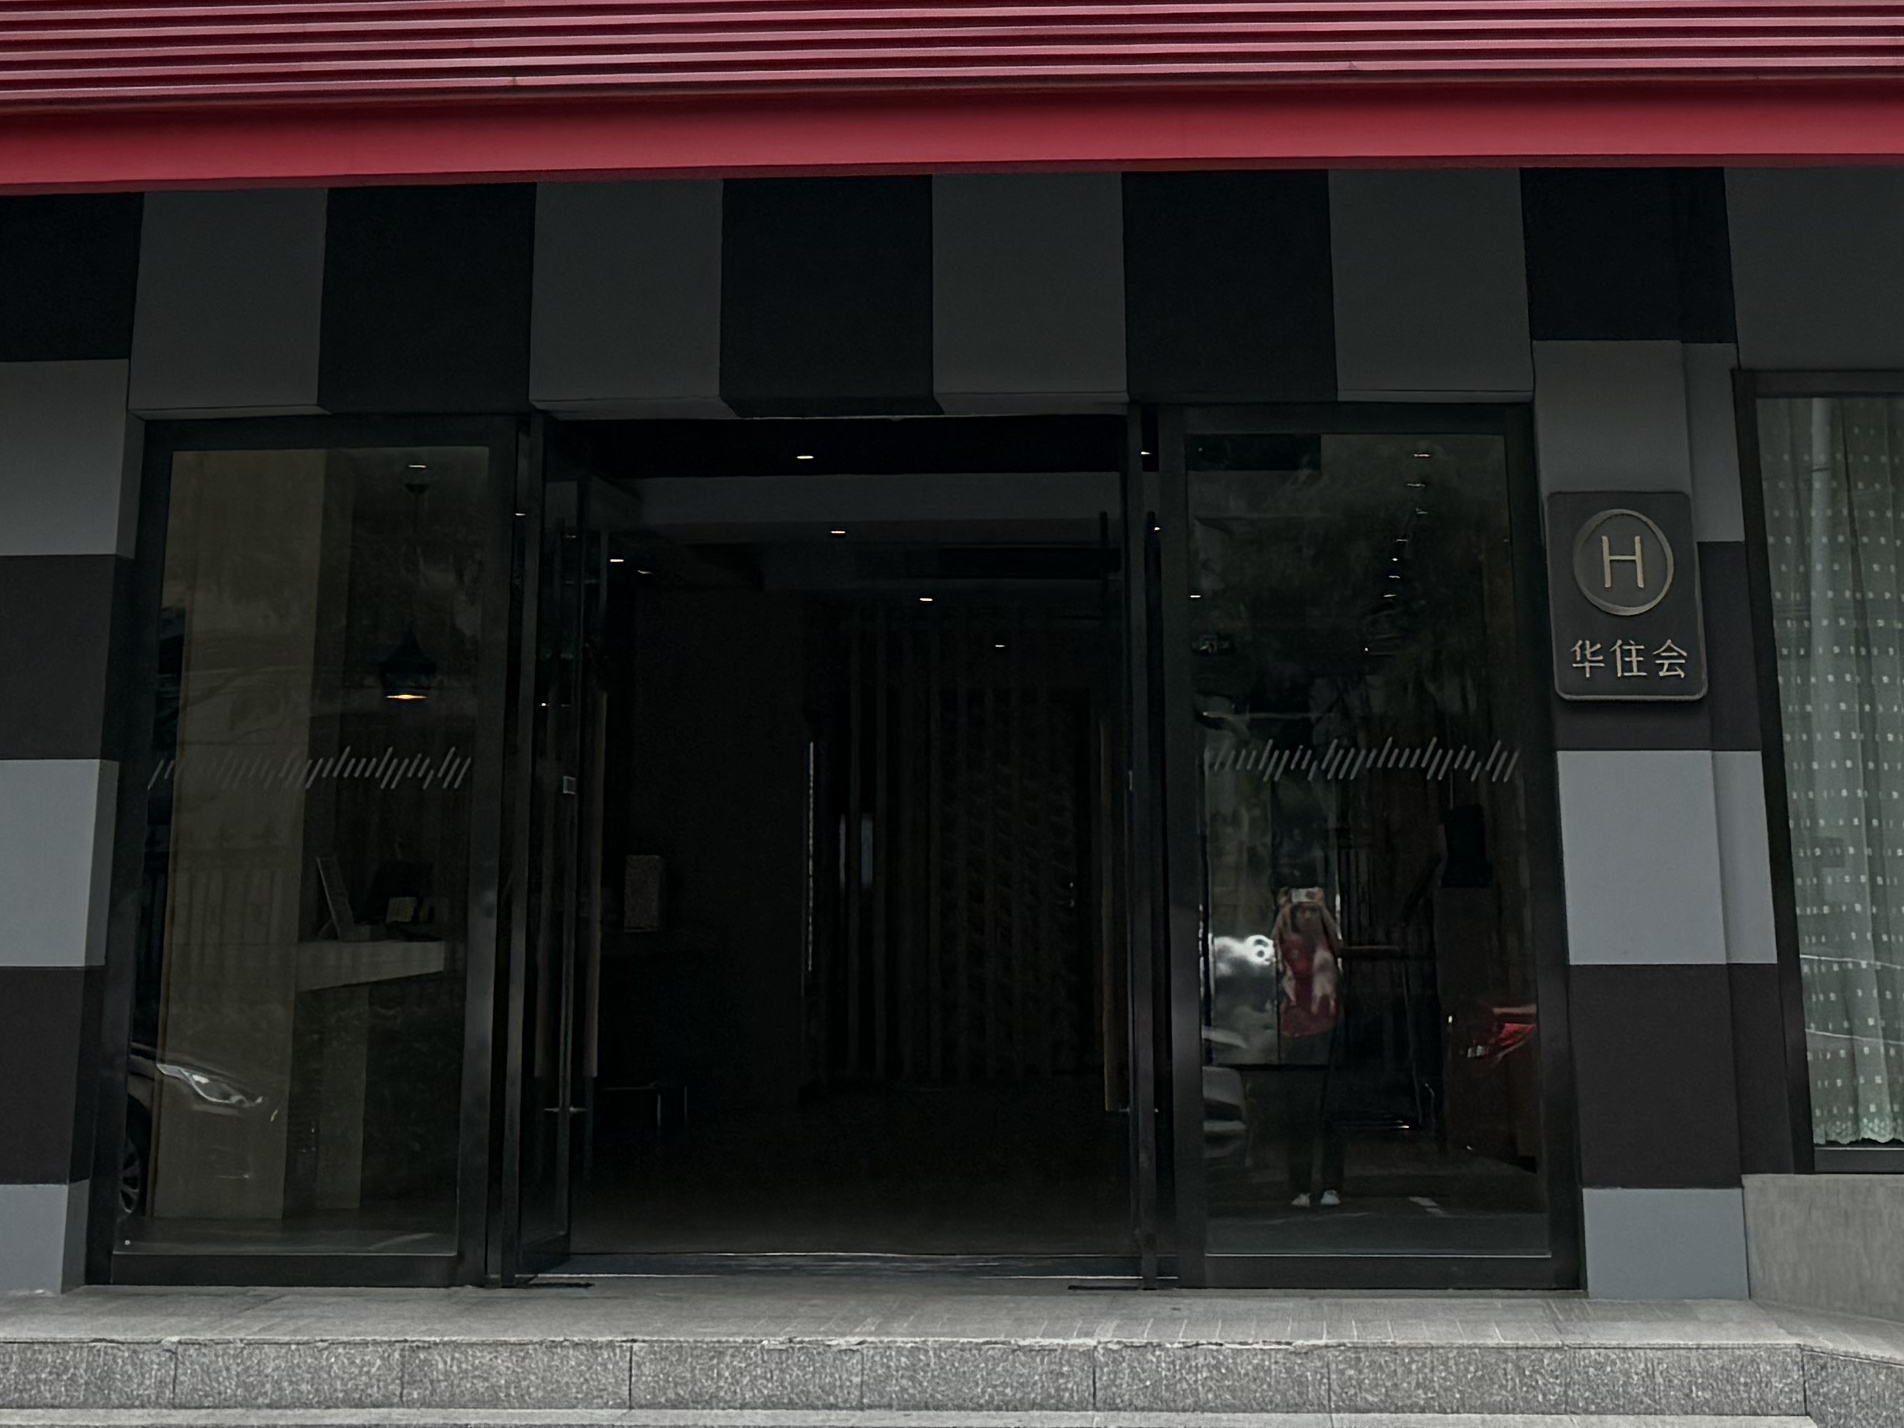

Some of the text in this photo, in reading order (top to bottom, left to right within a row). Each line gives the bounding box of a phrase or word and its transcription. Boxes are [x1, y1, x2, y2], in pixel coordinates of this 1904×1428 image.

[1601, 535, 1646, 591] H
[1570, 638, 1688, 679] 华住会
